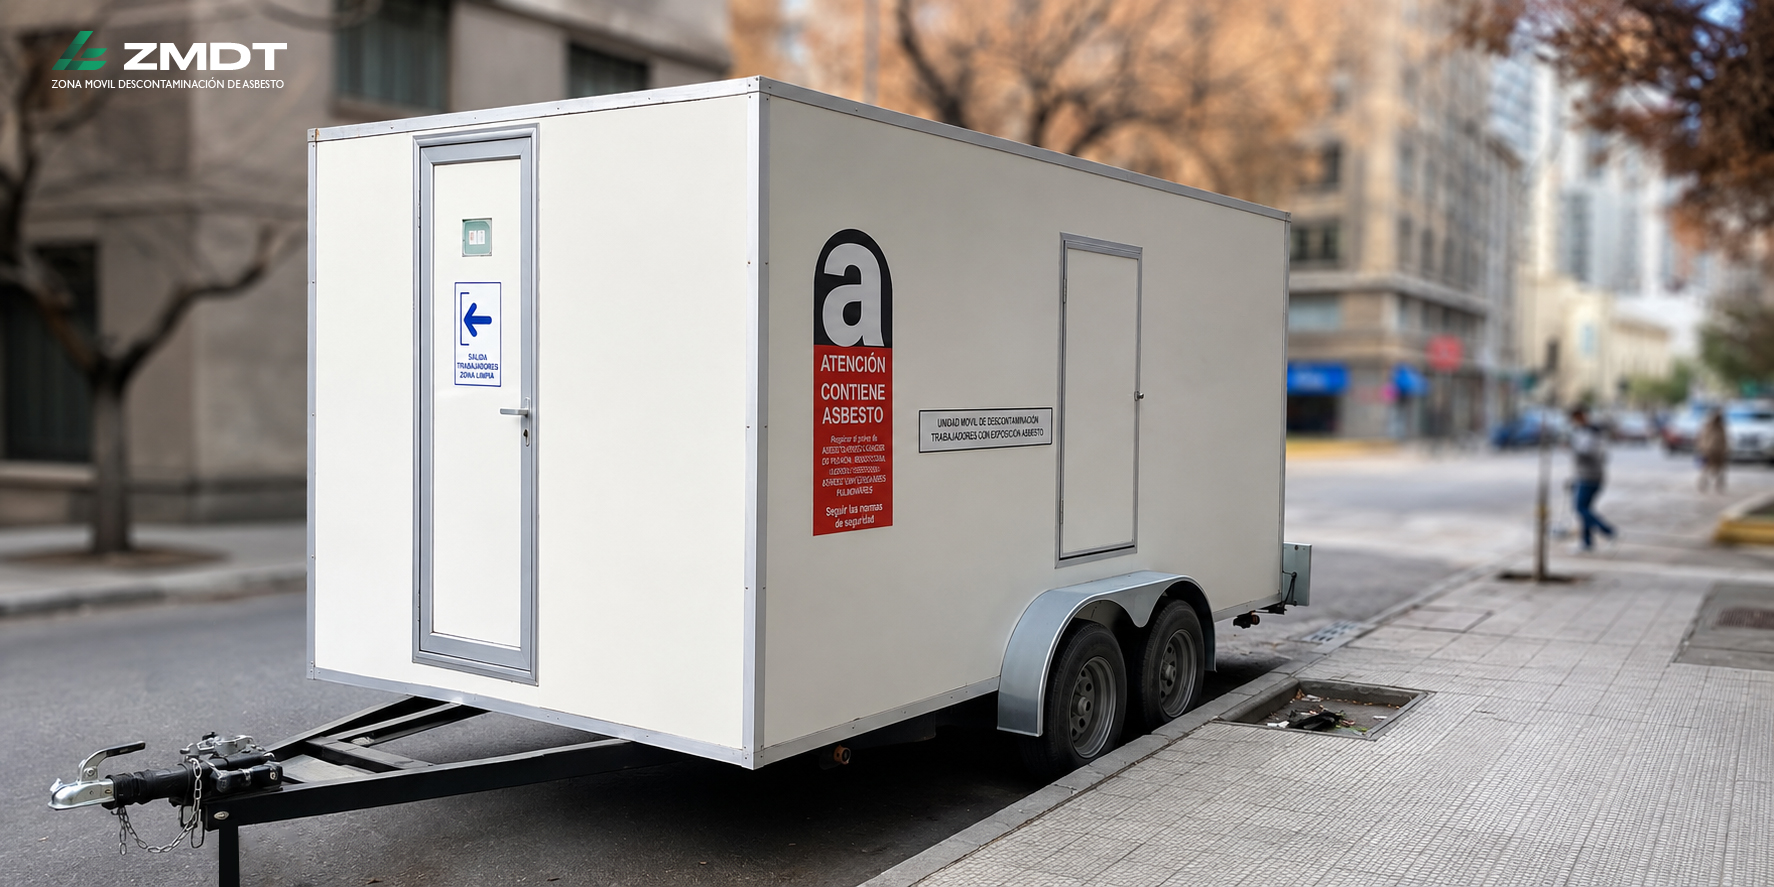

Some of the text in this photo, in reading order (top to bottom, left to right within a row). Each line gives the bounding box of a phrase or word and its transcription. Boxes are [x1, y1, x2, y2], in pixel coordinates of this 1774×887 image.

[822, 242, 885, 348] a
[820, 351, 886, 373] ATENCIÓN
[821, 383, 886, 401] CONTIENE
[822, 406, 884, 425] ASBESTO
[979, 417, 987, 426] DE
[835, 518, 843, 528] de
